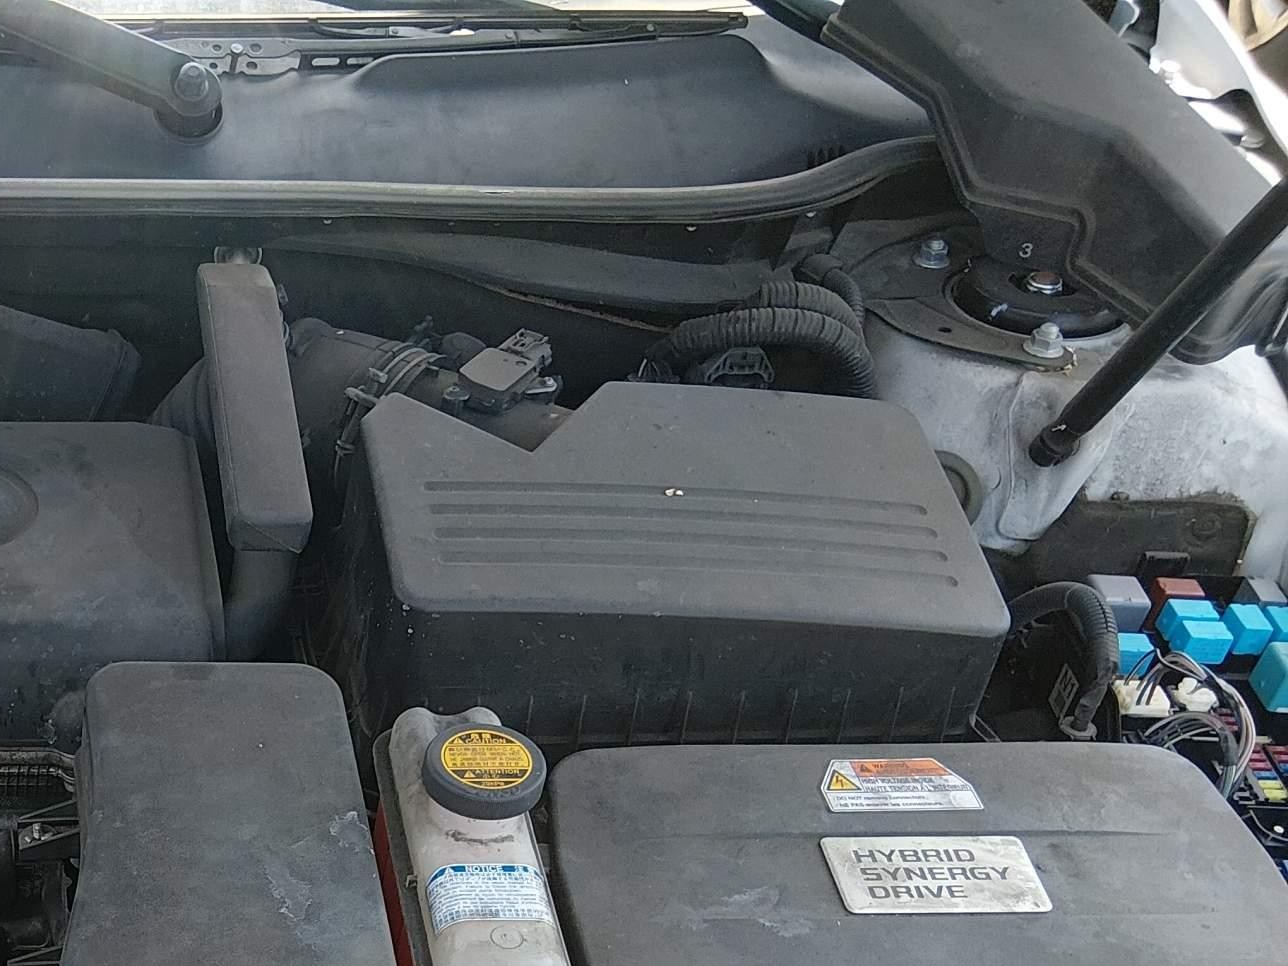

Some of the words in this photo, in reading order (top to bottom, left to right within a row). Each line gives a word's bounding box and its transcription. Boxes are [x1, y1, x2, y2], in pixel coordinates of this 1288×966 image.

[1019, 243, 1033, 258] 3
[853, 849, 975, 863] HYBRID
[860, 866, 1009, 881] SYNERGY
[868, 885, 968, 899] DRIVE
